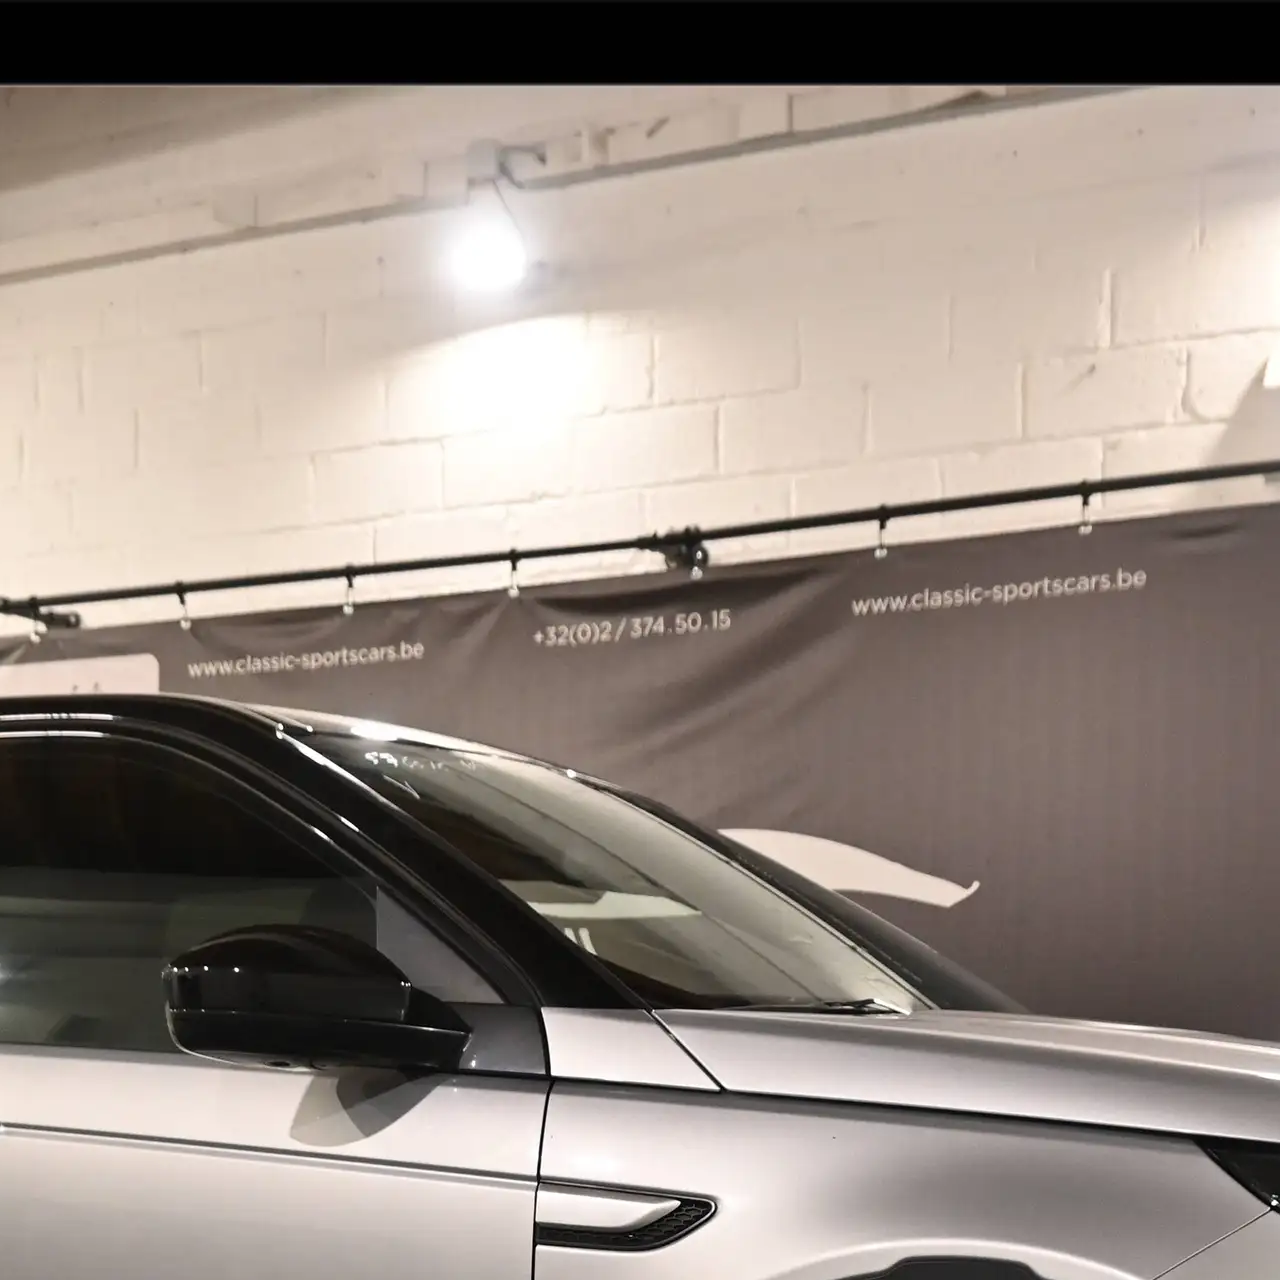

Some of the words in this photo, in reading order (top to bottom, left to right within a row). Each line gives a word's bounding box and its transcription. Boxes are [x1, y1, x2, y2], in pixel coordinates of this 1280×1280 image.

[851, 567, 1149, 617] www.classic-sportscars.be
[630, 608, 733, 640] 374.50.15
[187, 641, 426, 679] www.classic-sportscars.be
